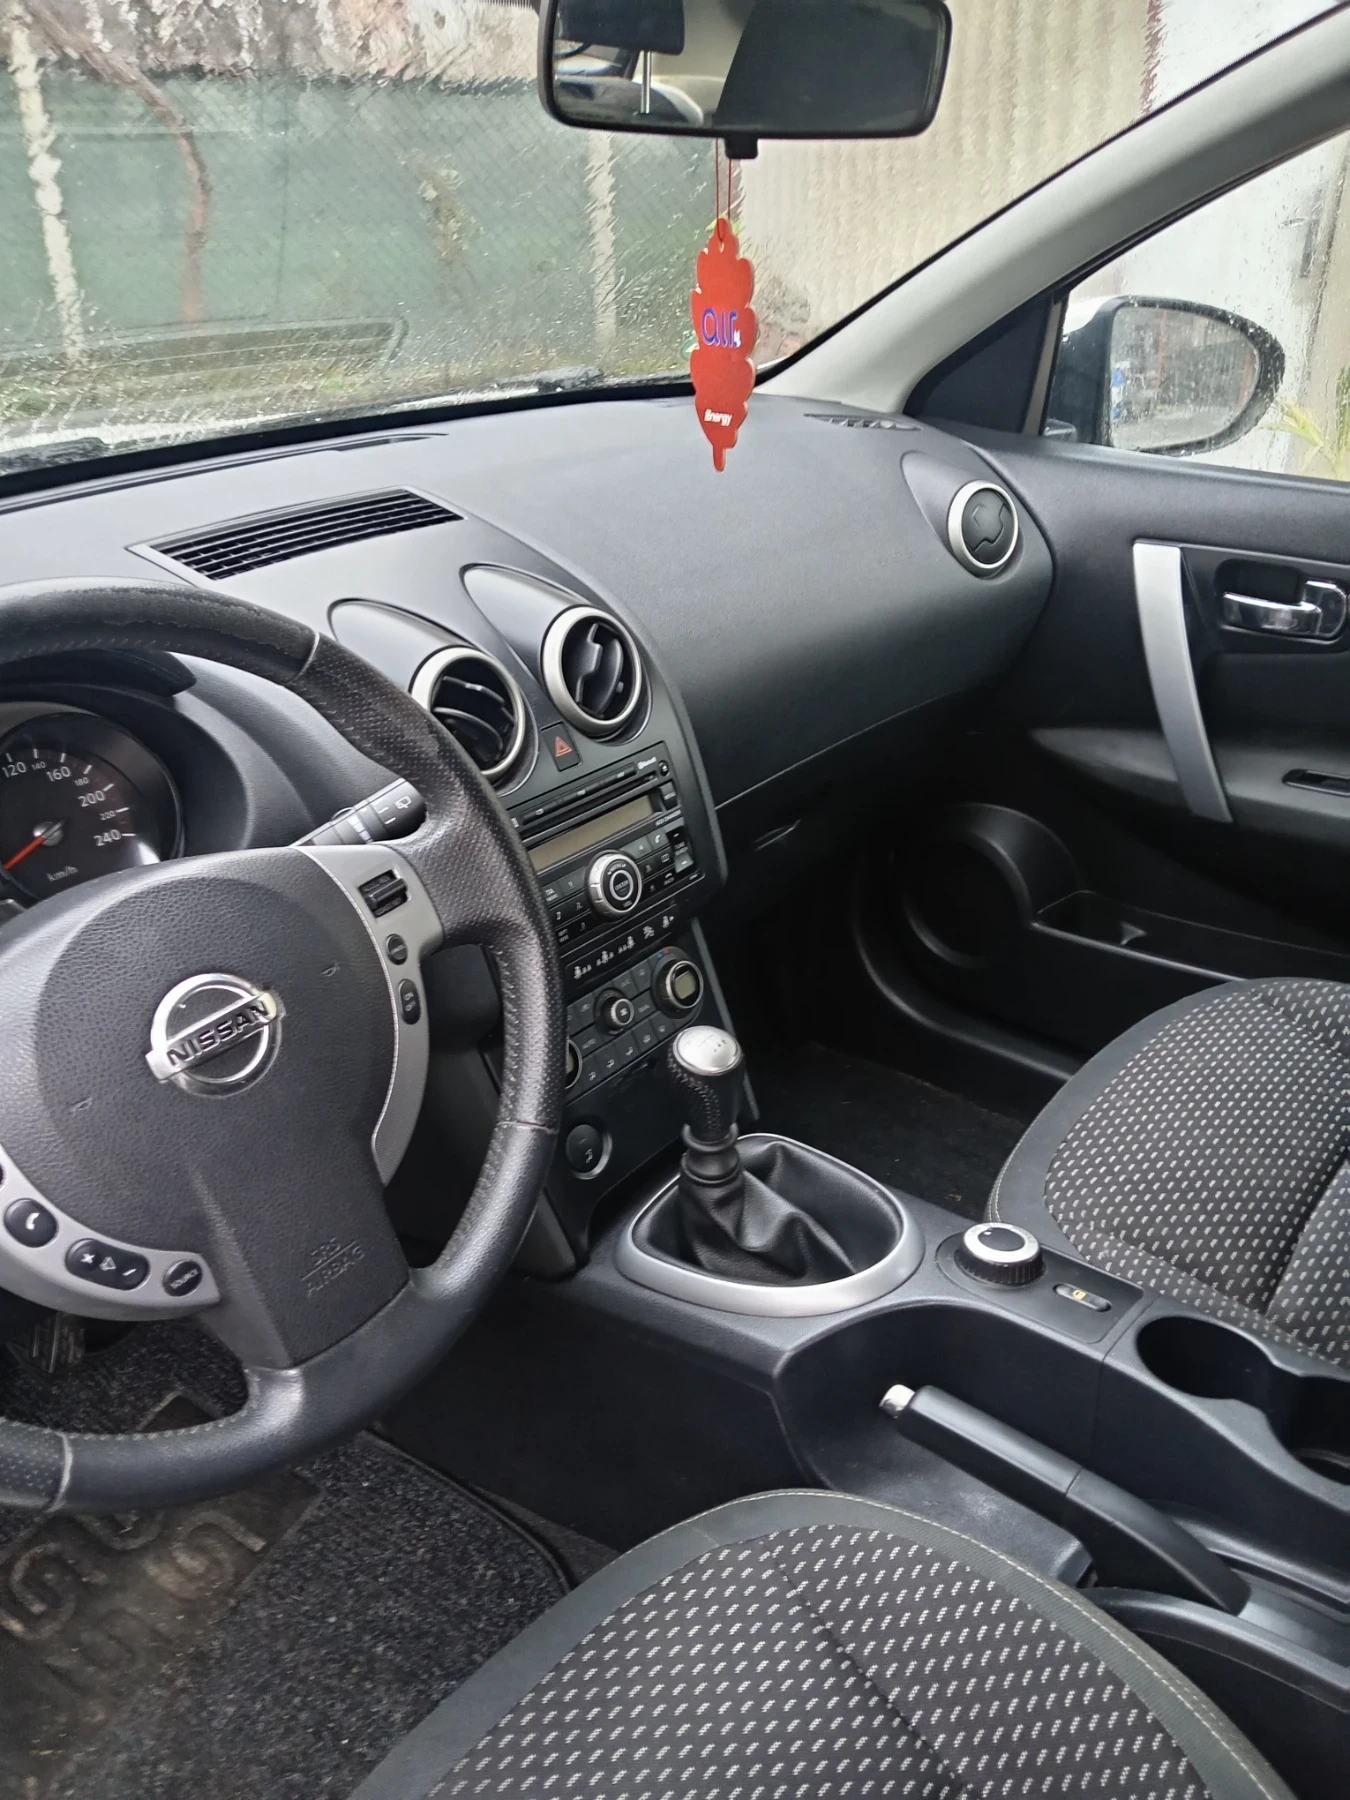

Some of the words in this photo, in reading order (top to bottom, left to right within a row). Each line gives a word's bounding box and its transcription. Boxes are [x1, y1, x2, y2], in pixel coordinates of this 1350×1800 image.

[704, 409, 733, 427] Energy
[2, 761, 27, 778] 120
[31, 761, 46, 771] 140
[46, 765, 72, 782] 160
[74, 776, 91, 787] 180
[77, 790, 106, 808] 200
[100, 810, 117, 821] 220
[93, 829, 122, 847] 240
[47, 865, 78, 882] km/h
[166, 999, 270, 1068] NISSAN
